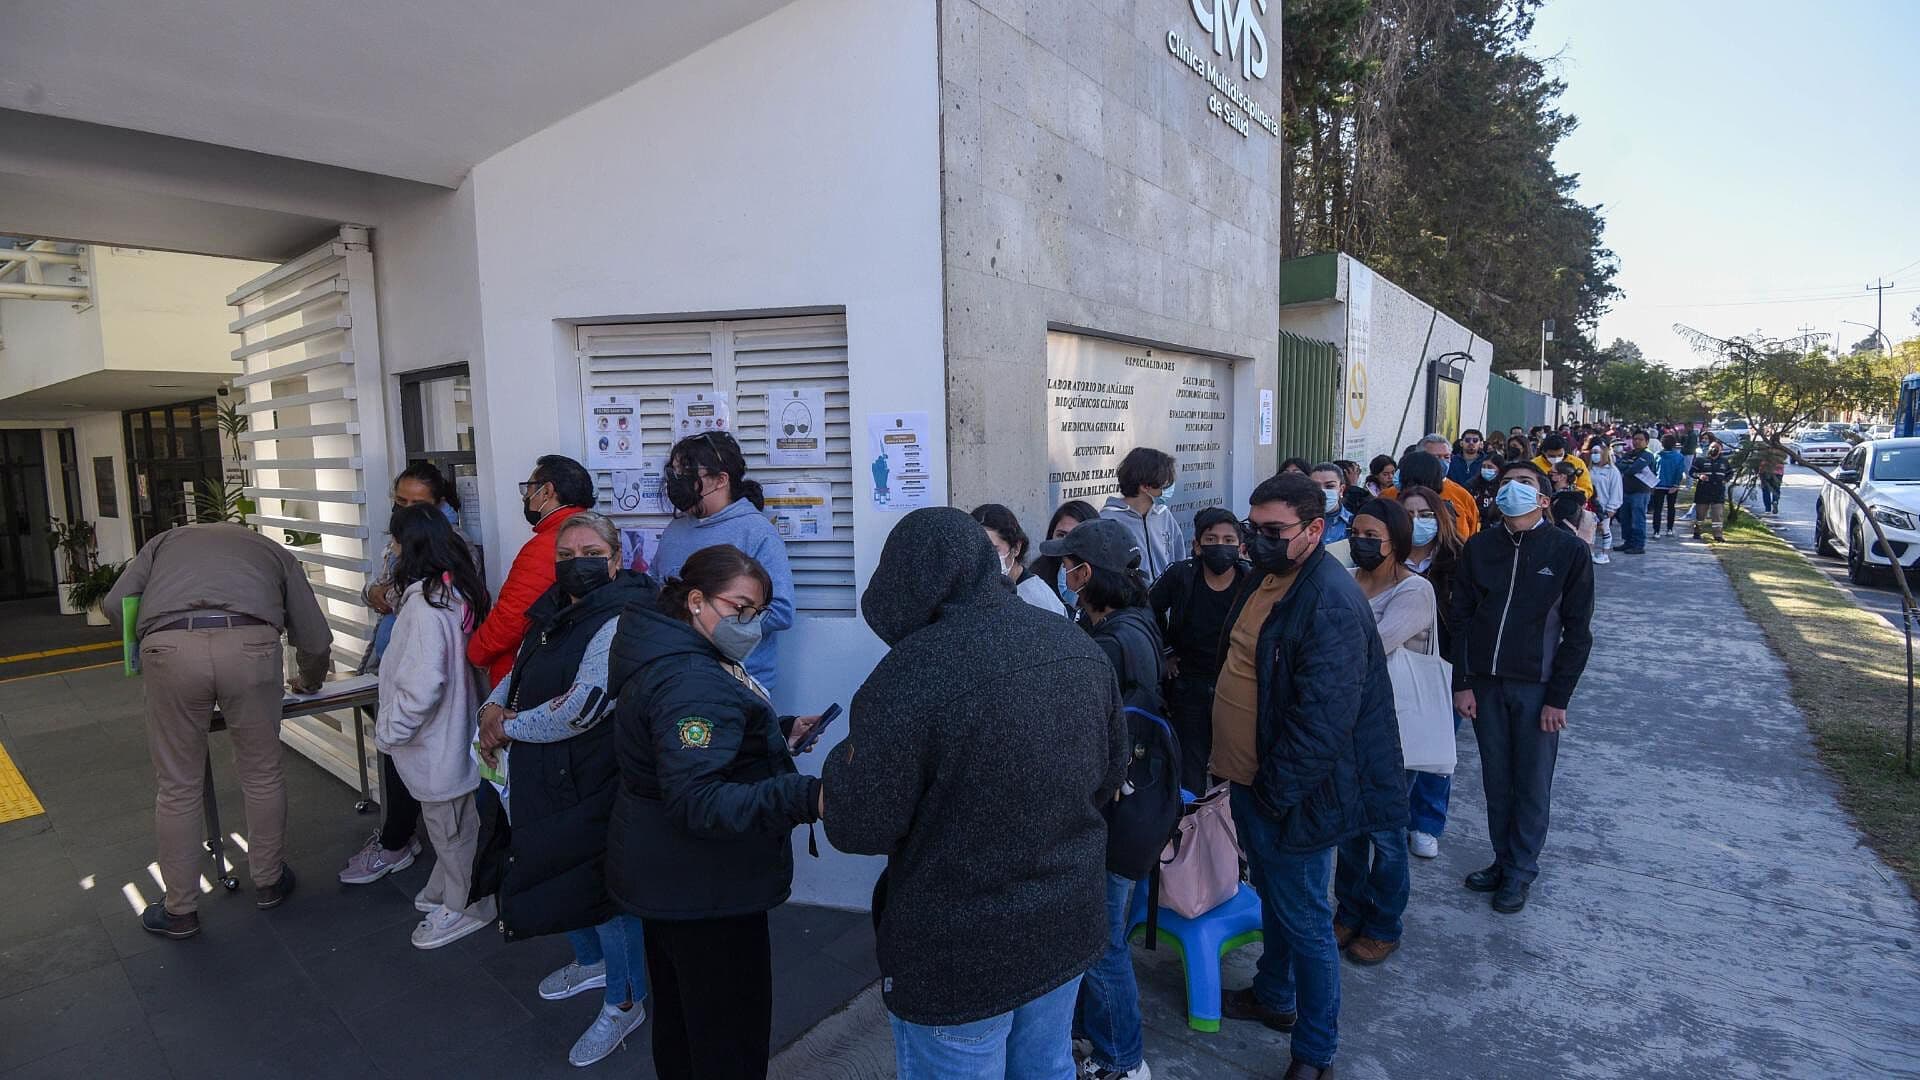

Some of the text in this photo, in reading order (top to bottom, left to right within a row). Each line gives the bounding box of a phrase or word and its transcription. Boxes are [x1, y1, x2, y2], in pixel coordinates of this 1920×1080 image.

[1166, 30, 1278, 137] Clínica Multidisciplinaria
[1208, 94, 1248, 137] de Salud
[1125, 356, 1175, 371] ESPECIALIDADES
[1047, 378, 1134, 395] LABORATORIO DE ANÁLISIS
[1182, 376, 1198, 386] SALUD
[1055, 395, 1129, 410] BIOQUÍMICOS CLÍNICOS
[1061, 421, 1125, 432] MEDICINA GENERAL
[1073, 446, 1115, 457] ACUPUNTURA
[1081, 470, 1090, 481] DE
[1063, 488, 1068, 499] Y
